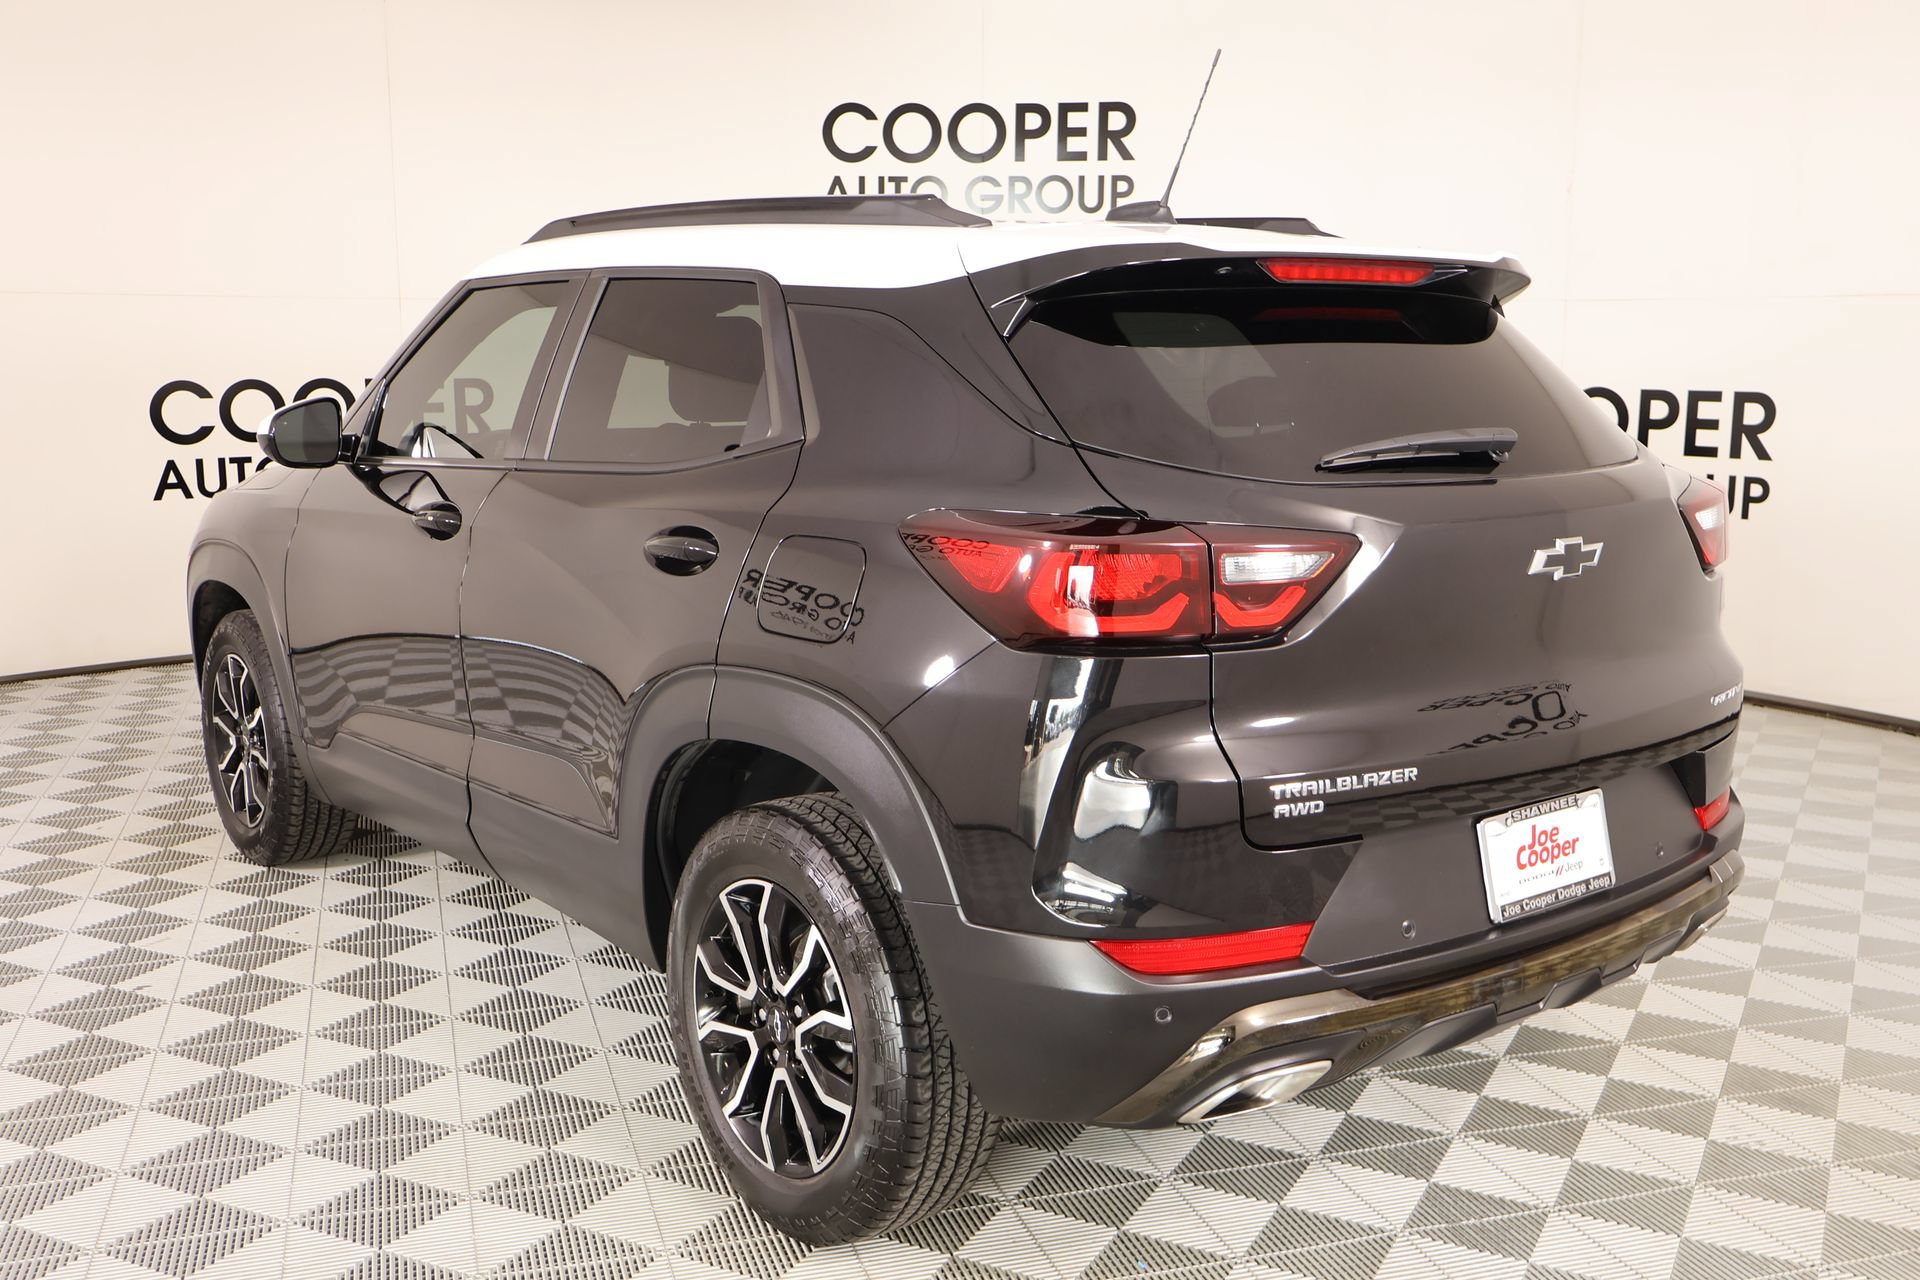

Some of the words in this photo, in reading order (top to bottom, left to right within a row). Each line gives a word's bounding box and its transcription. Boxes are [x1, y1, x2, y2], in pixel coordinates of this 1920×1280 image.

[822, 101, 1137, 163] COOPER
[964, 174, 1135, 215] GROUP
[1269, 767, 1418, 800] TRAILBLAZER
[1273, 800, 1324, 819] AWD
[1511, 796, 1577, 822] SHAWNEE
[1516, 837, 1579, 870] Cooper
[1527, 824, 1560, 850] Joe
[1564, 860, 1584, 873] Jeep
[1503, 904, 1521, 918] Joe
[1522, 892, 1556, 908] Cooper
[1557, 882, 1587, 900] Dodge
[1588, 874, 1610, 890] Jeep
